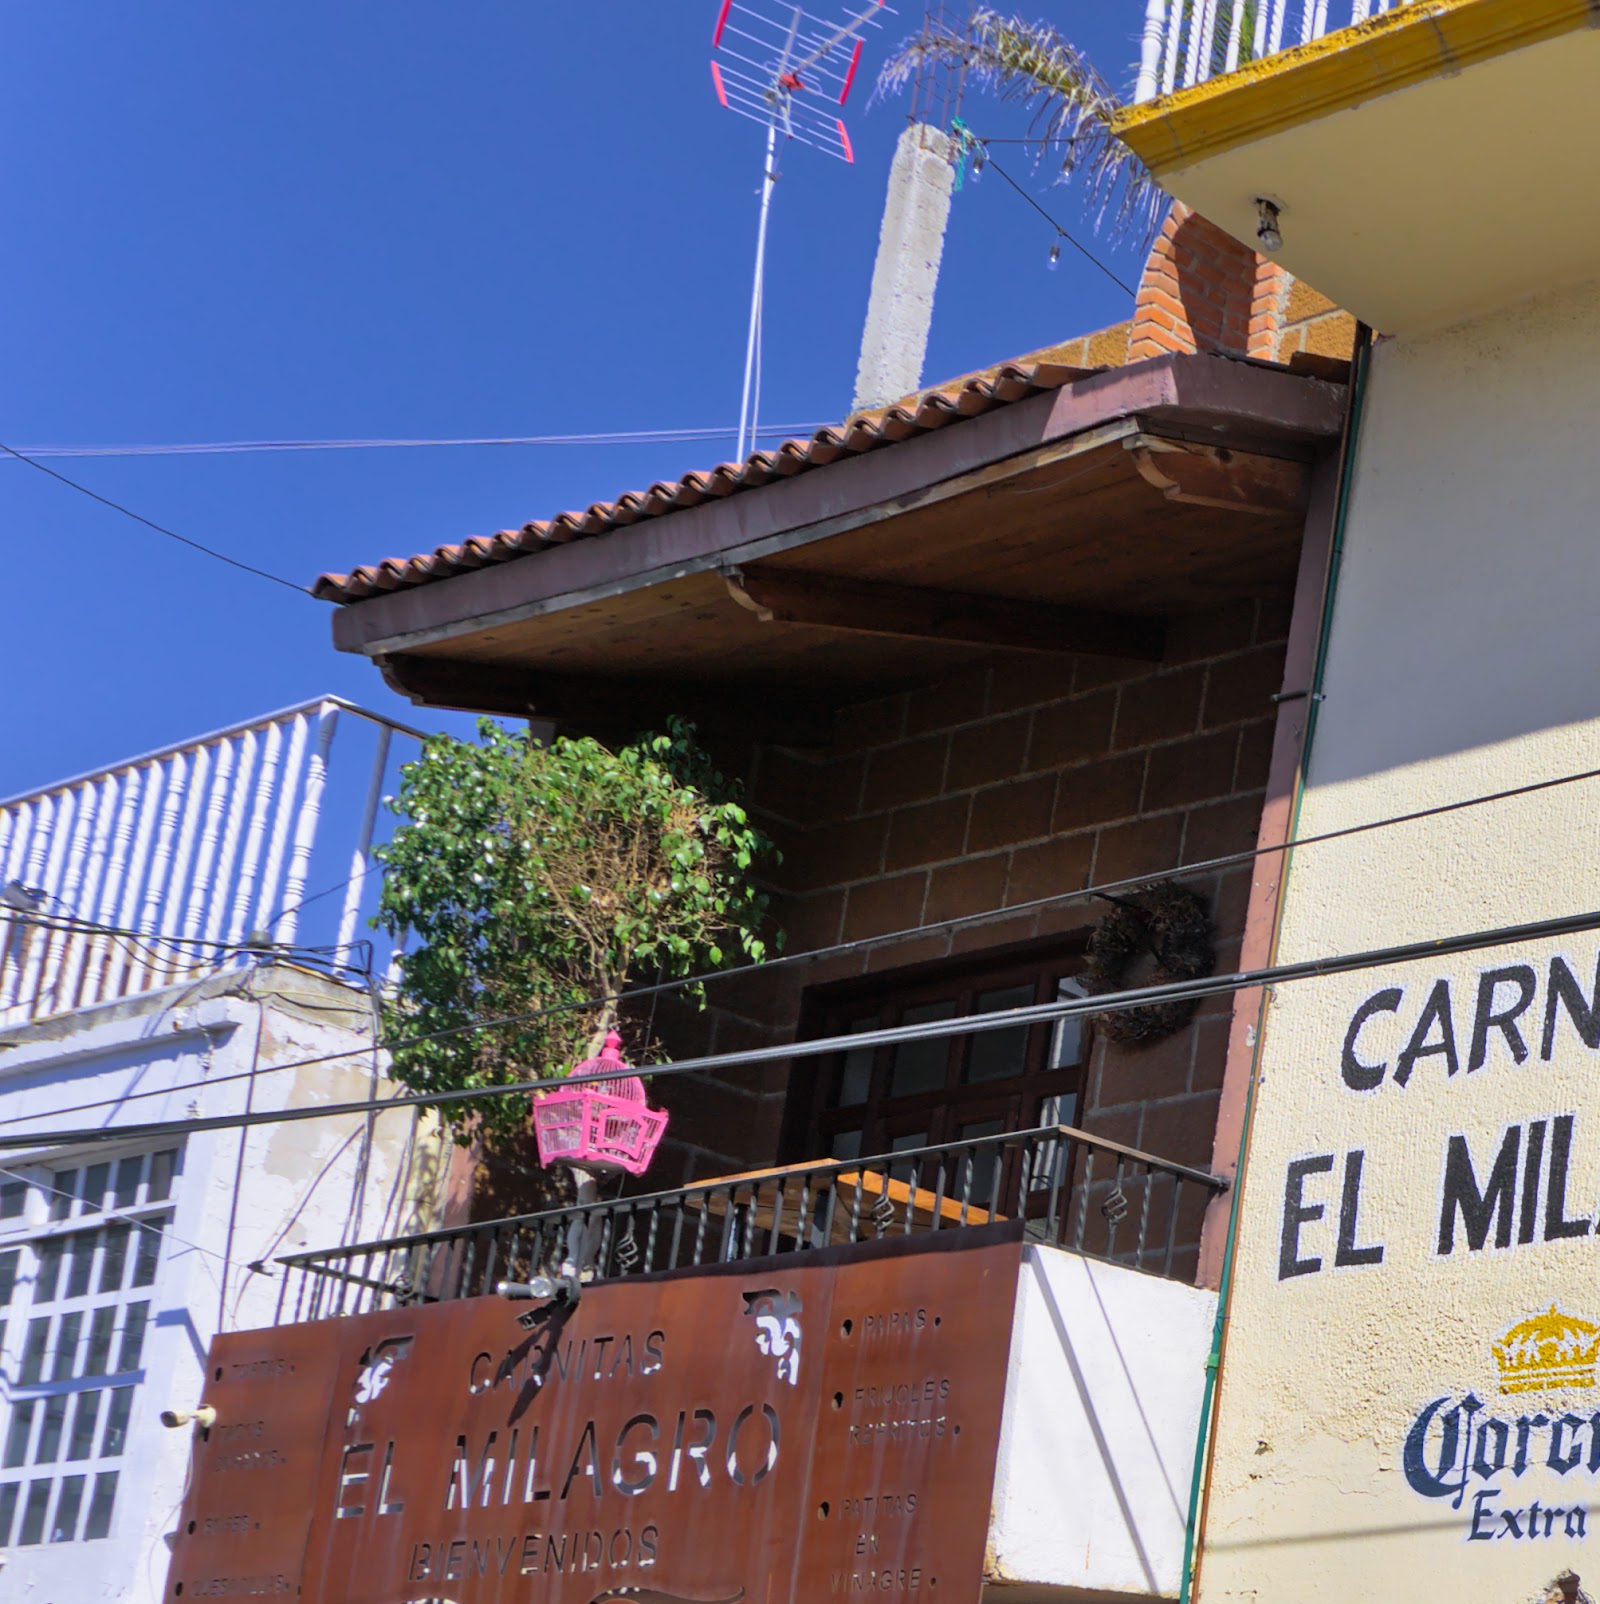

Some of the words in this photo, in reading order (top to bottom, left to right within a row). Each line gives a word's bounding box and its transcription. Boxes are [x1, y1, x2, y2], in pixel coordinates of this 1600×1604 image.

[1277, 1149, 1384, 1282] EL
[863, 1309, 927, 1335] PAPAS
[469, 1330, 665, 1394] CARNITAS
[855, 1379, 951, 1407] FRIJOLES
[850, 1416, 947, 1445] REFRITOS
[337, 1441, 404, 1519] EL
[445, 1403, 781, 1510] MILAGRO
[839, 1493, 917, 1519] PATITAS
[1467, 1489, 1588, 1542] Extra
[408, 1525, 659, 1581] BIENVENIDOS
[856, 1534, 880, 1554] EN
[831, 1568, 922, 1594] VINAGRE
